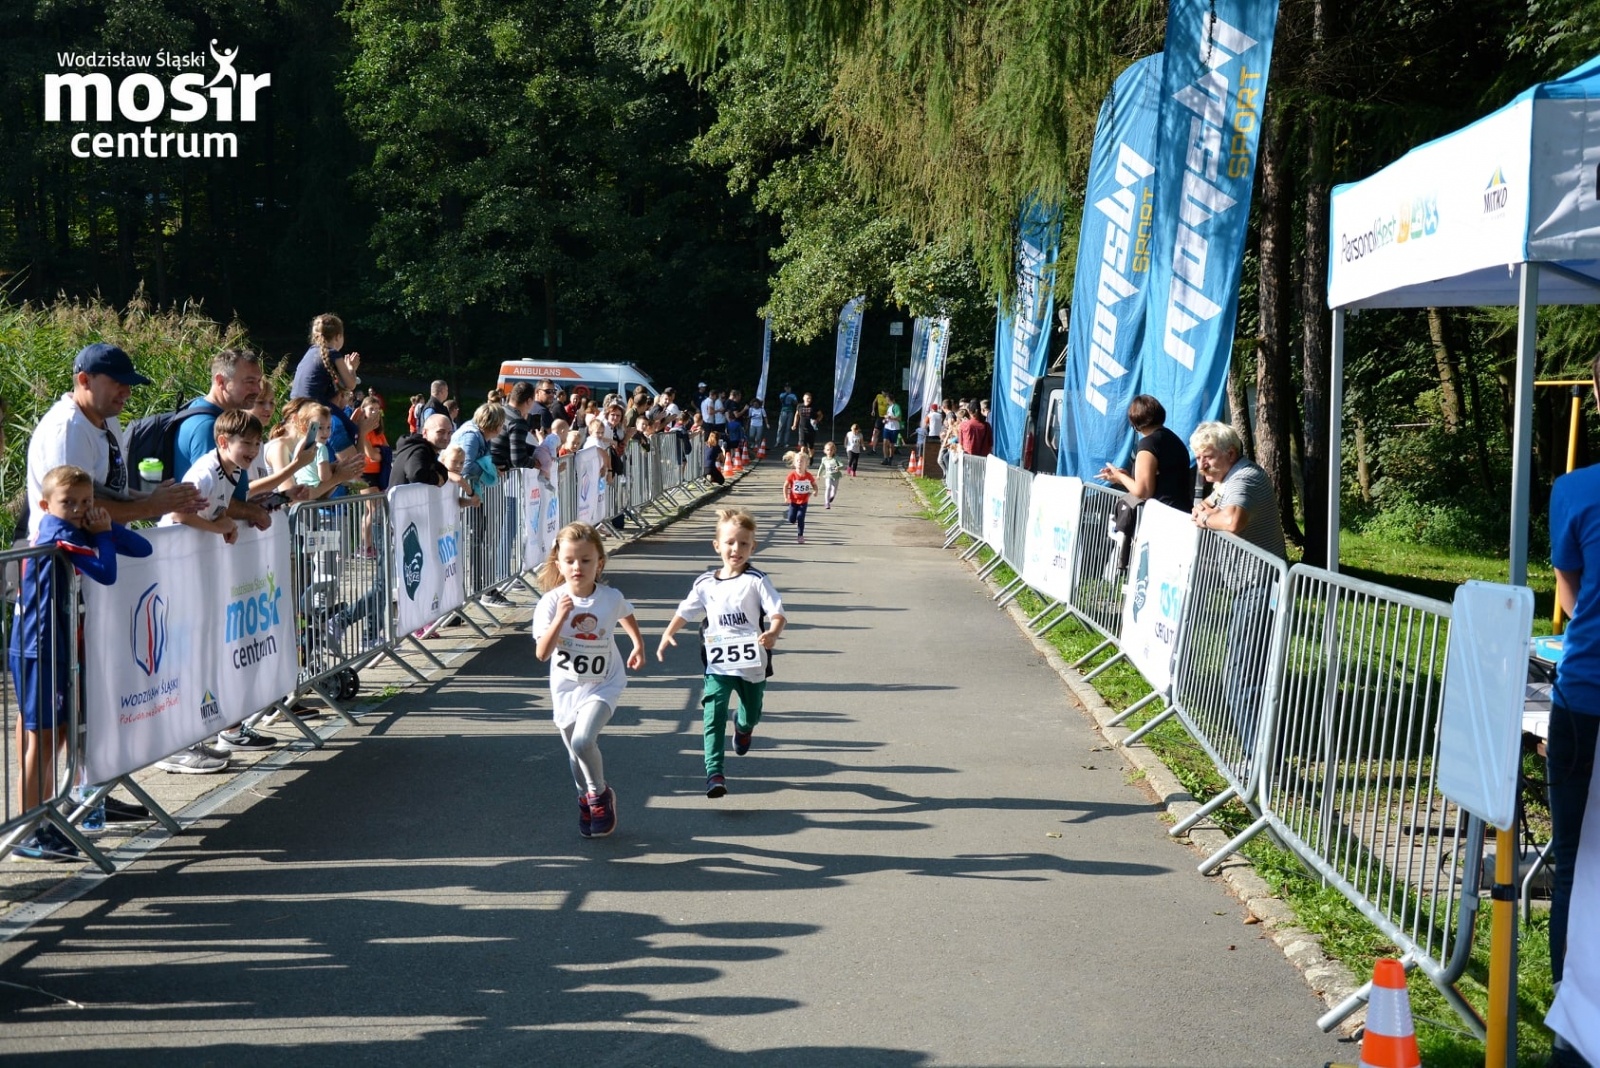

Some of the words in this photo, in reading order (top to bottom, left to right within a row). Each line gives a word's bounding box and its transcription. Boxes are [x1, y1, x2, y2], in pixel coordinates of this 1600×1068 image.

[1228, 66, 1261, 179] SPORT
[1484, 187, 1507, 213] MITKO
[513, 367, 561, 376] AMBULANS
[794, 484, 810, 492] 258
[557, 650, 606, 675] 260
[710, 643, 757, 664] 255
